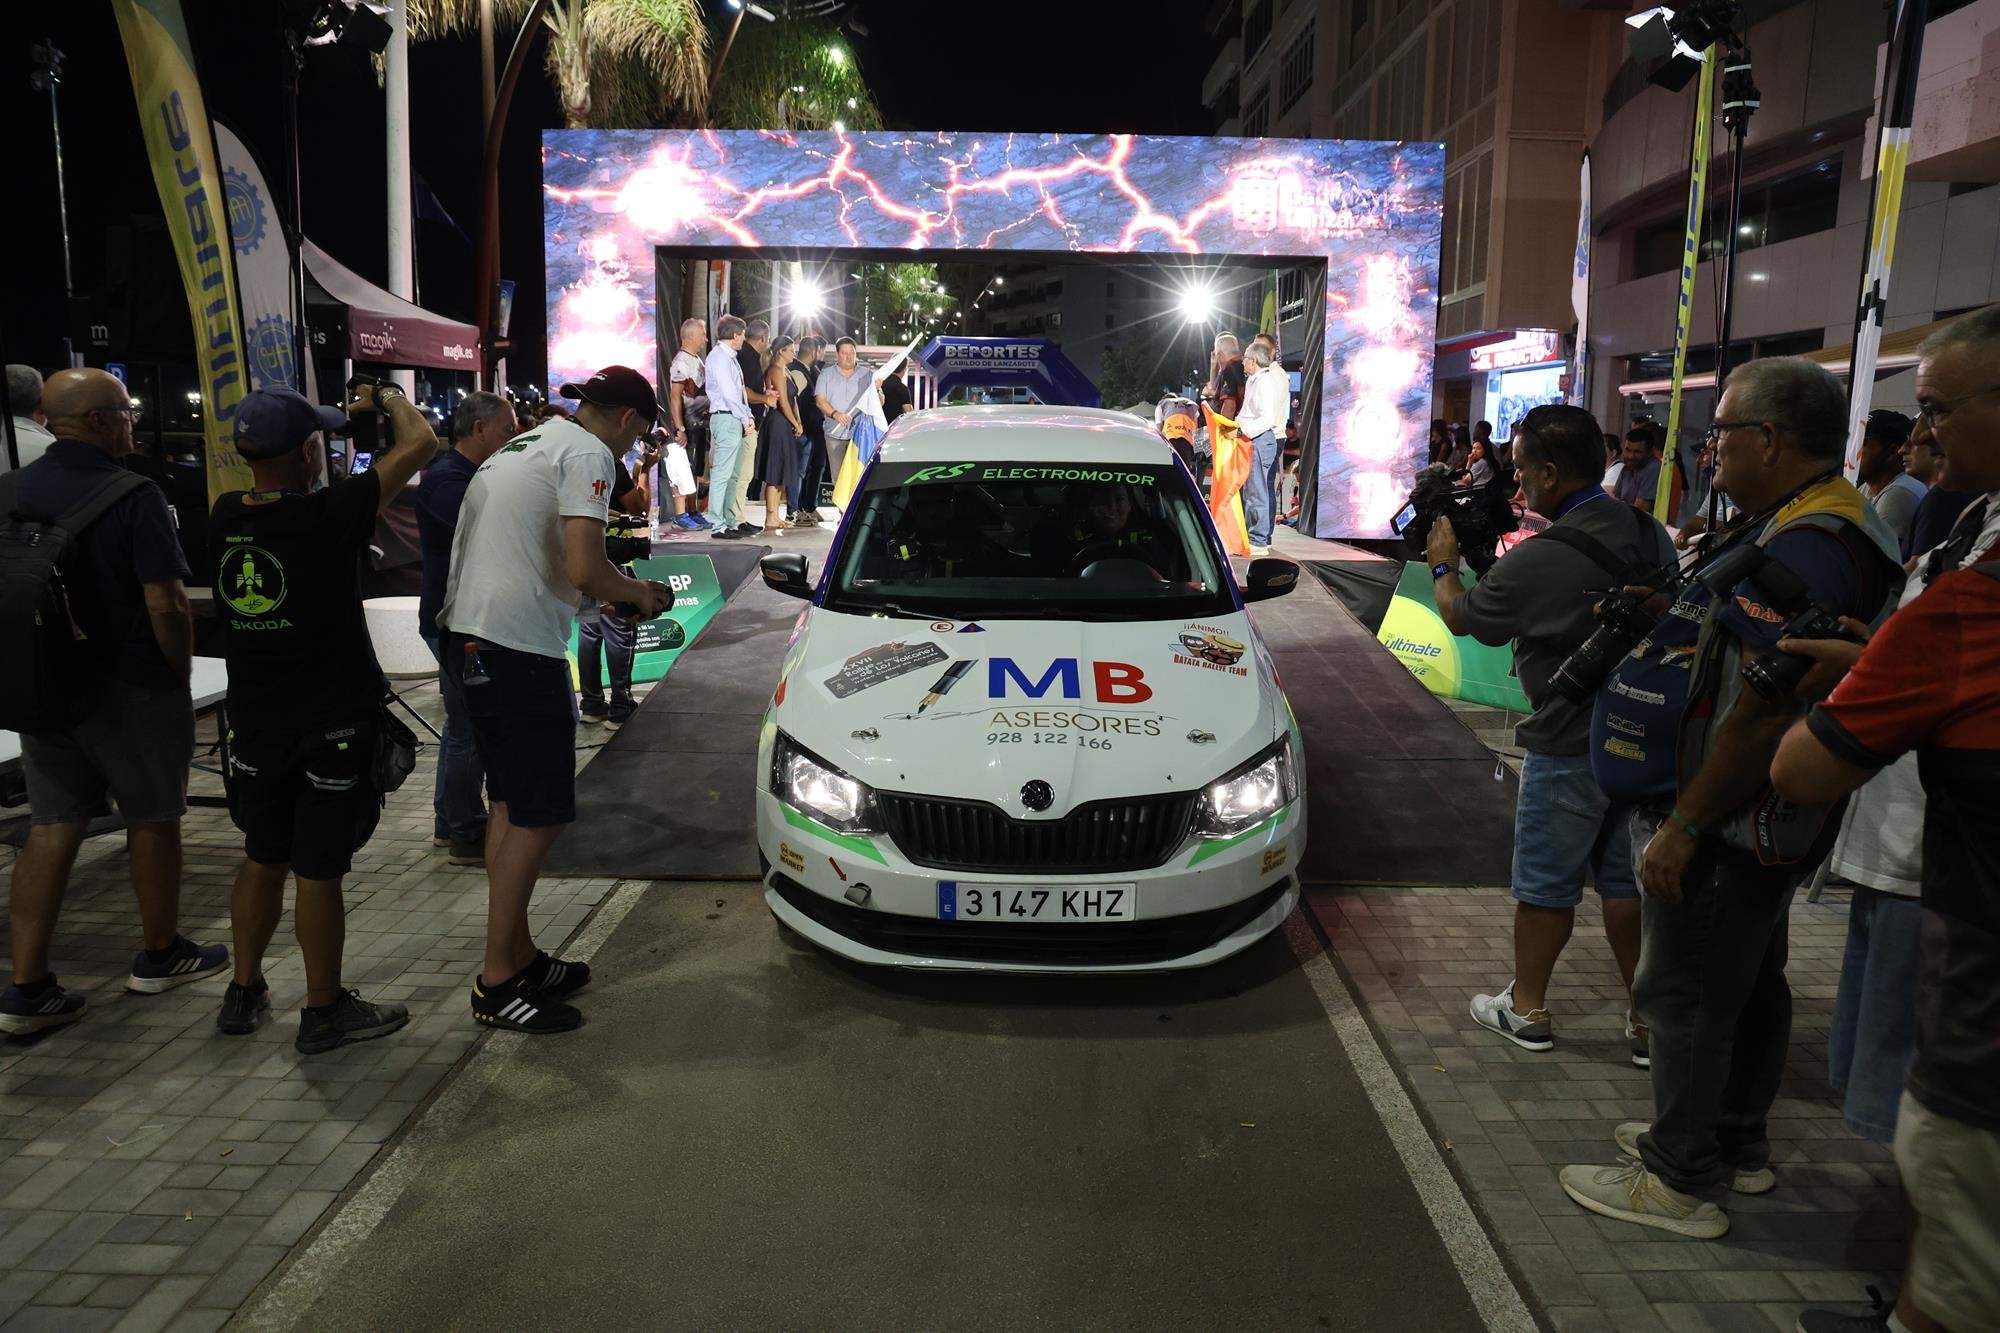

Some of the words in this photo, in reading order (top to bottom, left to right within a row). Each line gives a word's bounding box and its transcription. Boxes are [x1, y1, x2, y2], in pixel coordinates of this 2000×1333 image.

[443, 344, 474, 361] magik.es
[945, 345, 1041, 359] DEPORTES
[903, 463, 976, 485] RS
[982, 468, 1156, 487] ELECTROMOTOR
[668, 574, 692, 592] BP
[1385, 637, 1442, 657] ultimate
[1173, 653, 1200, 668] BATATA
[1202, 661, 1227, 673] RALLYE
[1228, 666, 1248, 677] TEAM
[989, 710, 1162, 736] ASESORES
[986, 732, 1023, 746] 928
[1033, 732, 1068, 745] 122
[1078, 735, 1113, 751] 166
[943, 904, 952, 913] E
[965, 889, 1050, 917] 3147
[1061, 890, 1124, 918] KHZ
